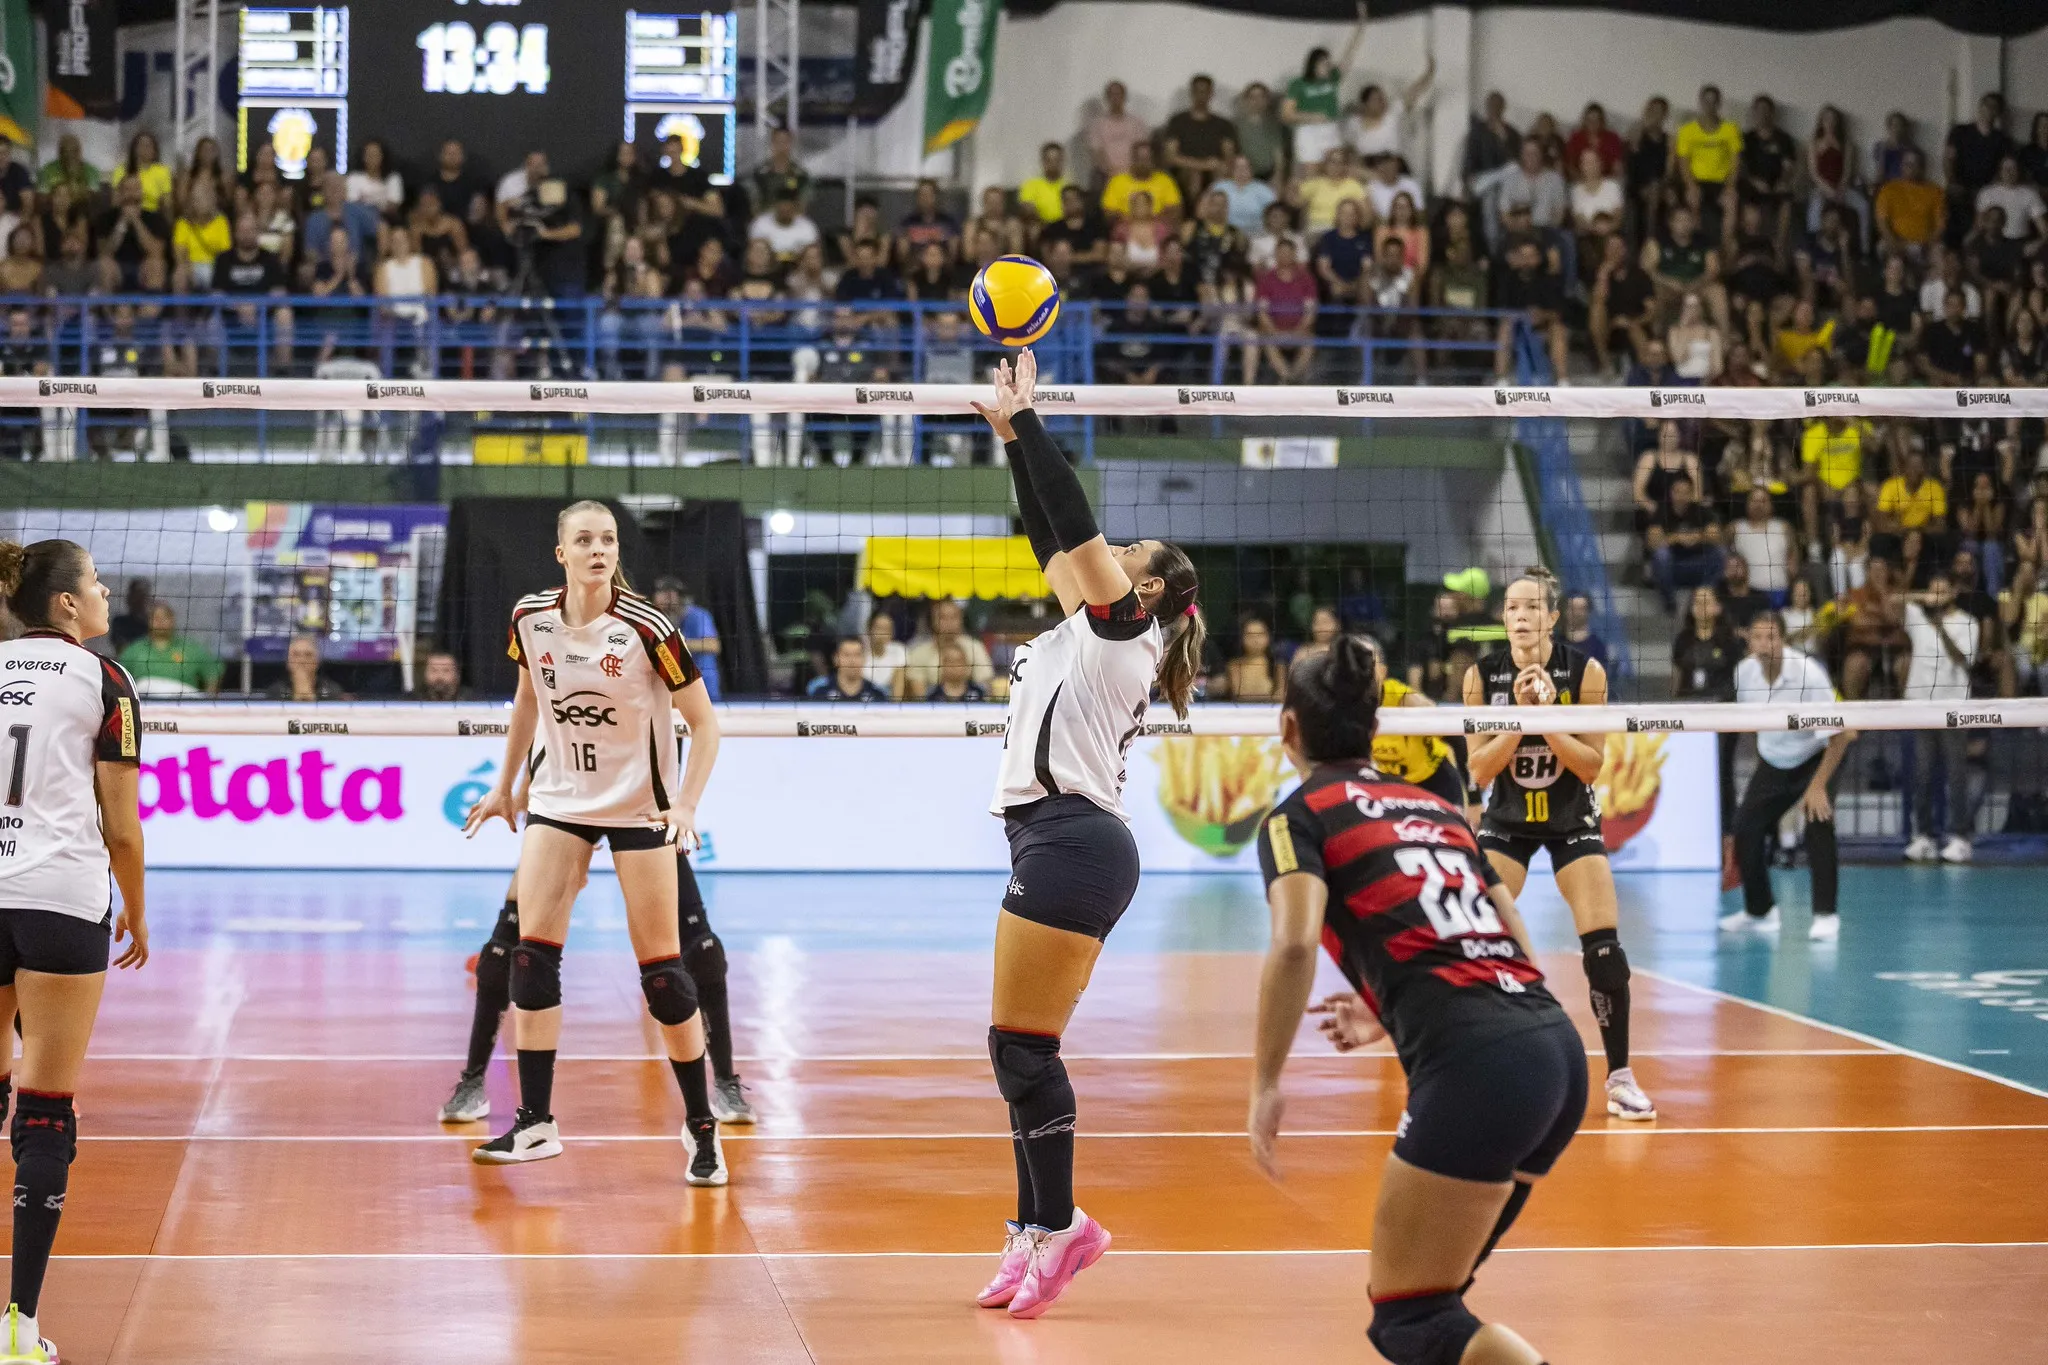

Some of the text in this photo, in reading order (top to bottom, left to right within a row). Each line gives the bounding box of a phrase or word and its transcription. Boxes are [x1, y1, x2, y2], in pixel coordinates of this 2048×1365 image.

[416, 20, 551, 95] 13:34
[52, 383, 97, 396] SUPERLIGA
[216, 384, 261, 398] SUPERLIGA
[380, 385, 425, 399] SUPERLIGA
[543, 386, 589, 400] SUPERLIGA
[707, 387, 751, 401] SUPERLIGA
[869, 390, 914, 403] SUPERLIGA
[1192, 390, 1235, 404] SUPERLIGA
[1351, 392, 1394, 405] SUPERLIGA
[1508, 392, 1553, 404] SUPERLIGA
[1663, 393, 1706, 407] SUPERLIGA
[1817, 392, 1860, 406] SUPERLIGA
[1969, 392, 2011, 406] SUPERLIGA
[5, 659, 67, 675] everest
[0, 685, 36, 706] esc
[551, 695, 618, 727] Sesc
[1477, 721, 1521, 733] SUPERLIGA
[1640, 719, 1684, 731] SUPERLIGA
[1801, 715, 1844, 729] SUPERLIGA
[1959, 714, 2002, 726] SUPERLIGA
[143, 721, 178, 734] PERLIGA
[302, 722, 348, 735] SUPERLIGA
[472, 722, 509, 736] SUPERLI
[811, 722, 857, 737] SUPERLIGA
[979, 722, 1005, 736] SUPER
[1146, 723, 1192, 735] SUPERLIGA
[571, 742, 597, 772] 16
[4, 723, 33, 808] 1
[1515, 754, 1558, 779] BH
[138, 746, 404, 823] atata
[1524, 790, 1549, 823] 10
[1393, 847, 1504, 939] 22
